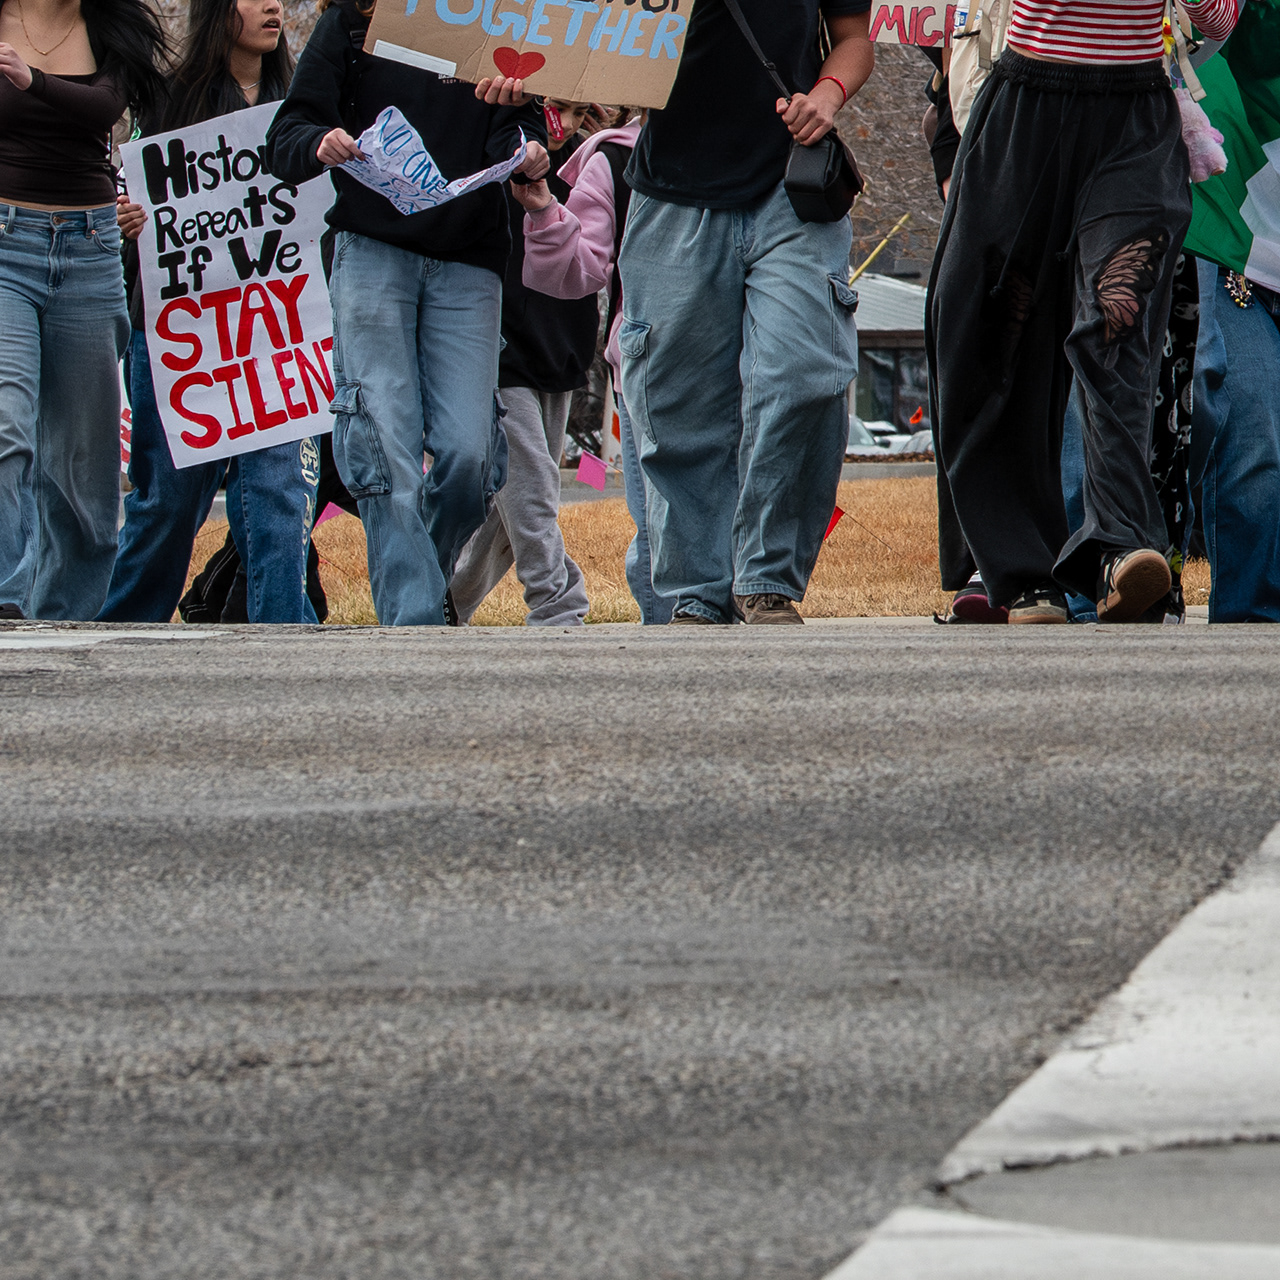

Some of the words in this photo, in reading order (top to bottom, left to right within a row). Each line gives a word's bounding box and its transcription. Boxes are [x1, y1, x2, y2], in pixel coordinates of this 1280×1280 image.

[157, 245, 213, 301] If
[227, 228, 303, 282] We
[155, 273, 310, 372] STAY
